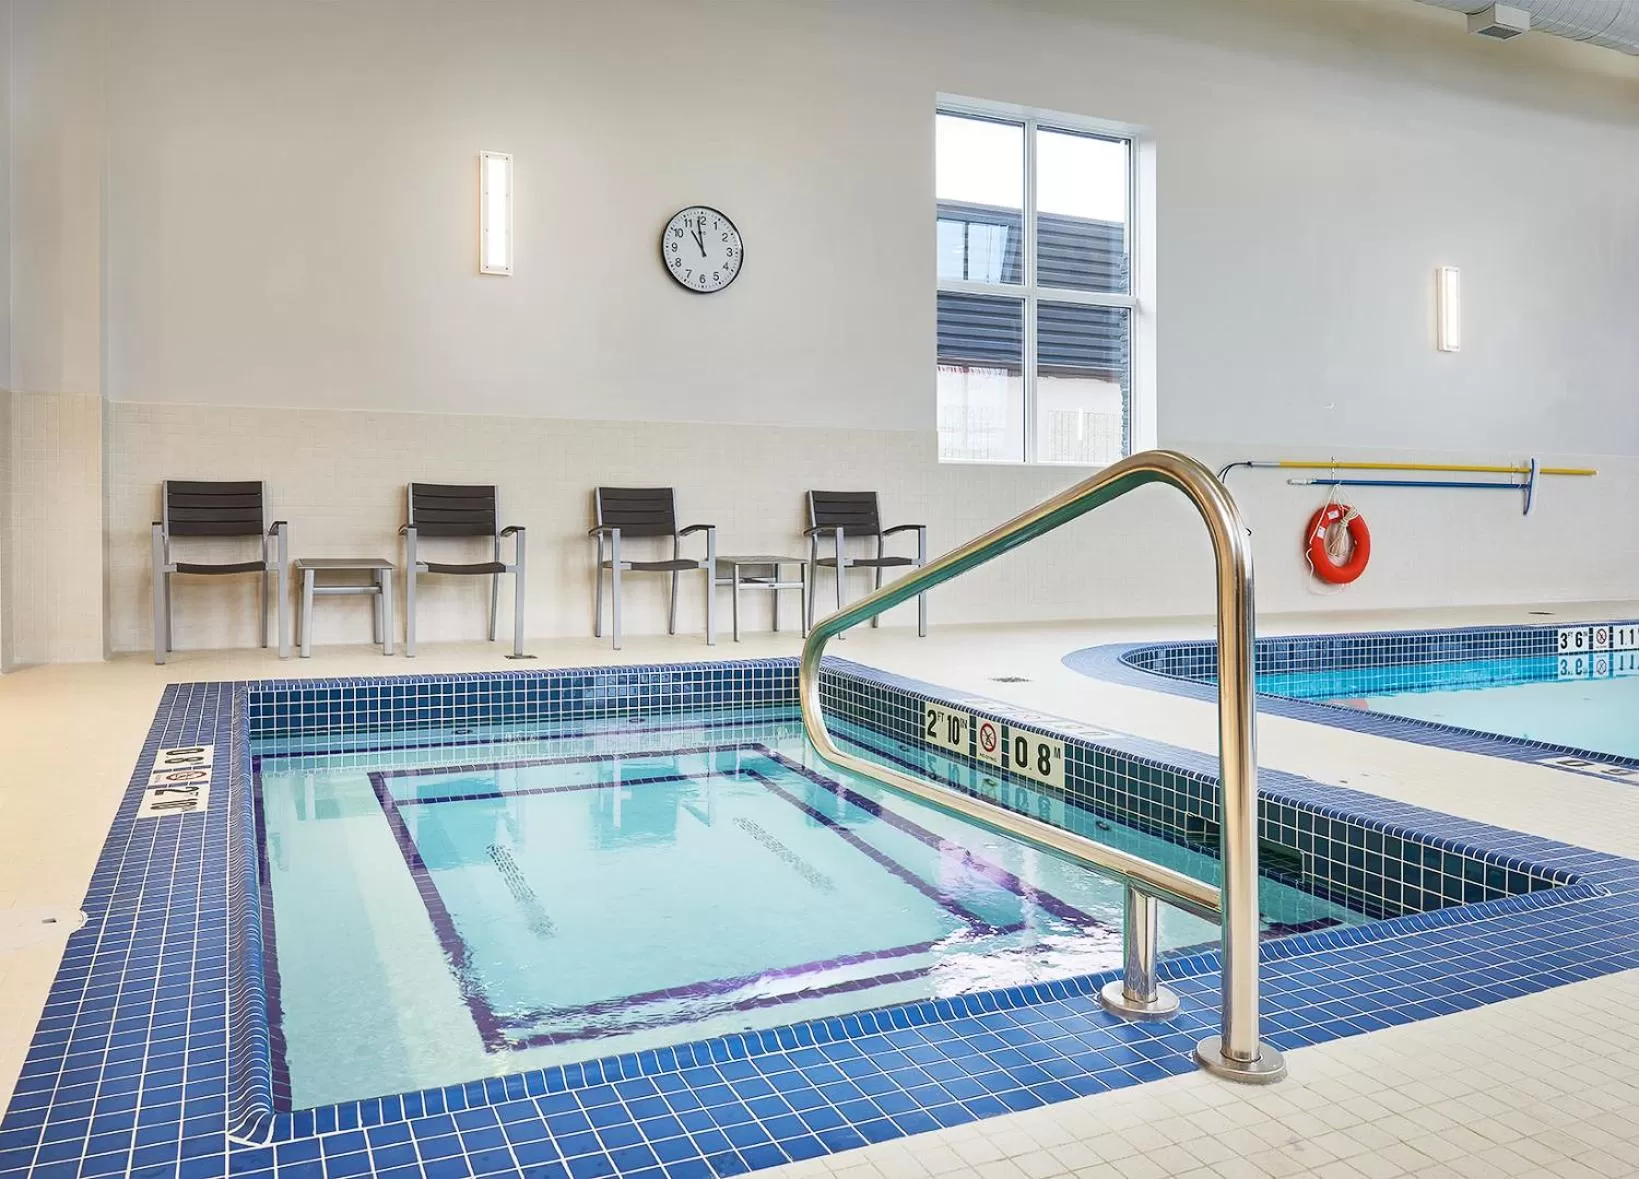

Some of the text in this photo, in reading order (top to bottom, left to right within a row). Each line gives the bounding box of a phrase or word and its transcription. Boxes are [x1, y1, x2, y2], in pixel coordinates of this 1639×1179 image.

[684, 218, 692, 228] 11
[713, 221, 718, 231] 1
[673, 228, 684, 238] 10
[722, 232, 728, 243] 2
[671, 242, 678, 253] 9
[726, 247, 733, 257] 3
[675, 258, 681, 268] 8
[685, 269, 692, 279] 7
[699, 274, 706, 283] 6
[713, 272, 719, 281] 5
